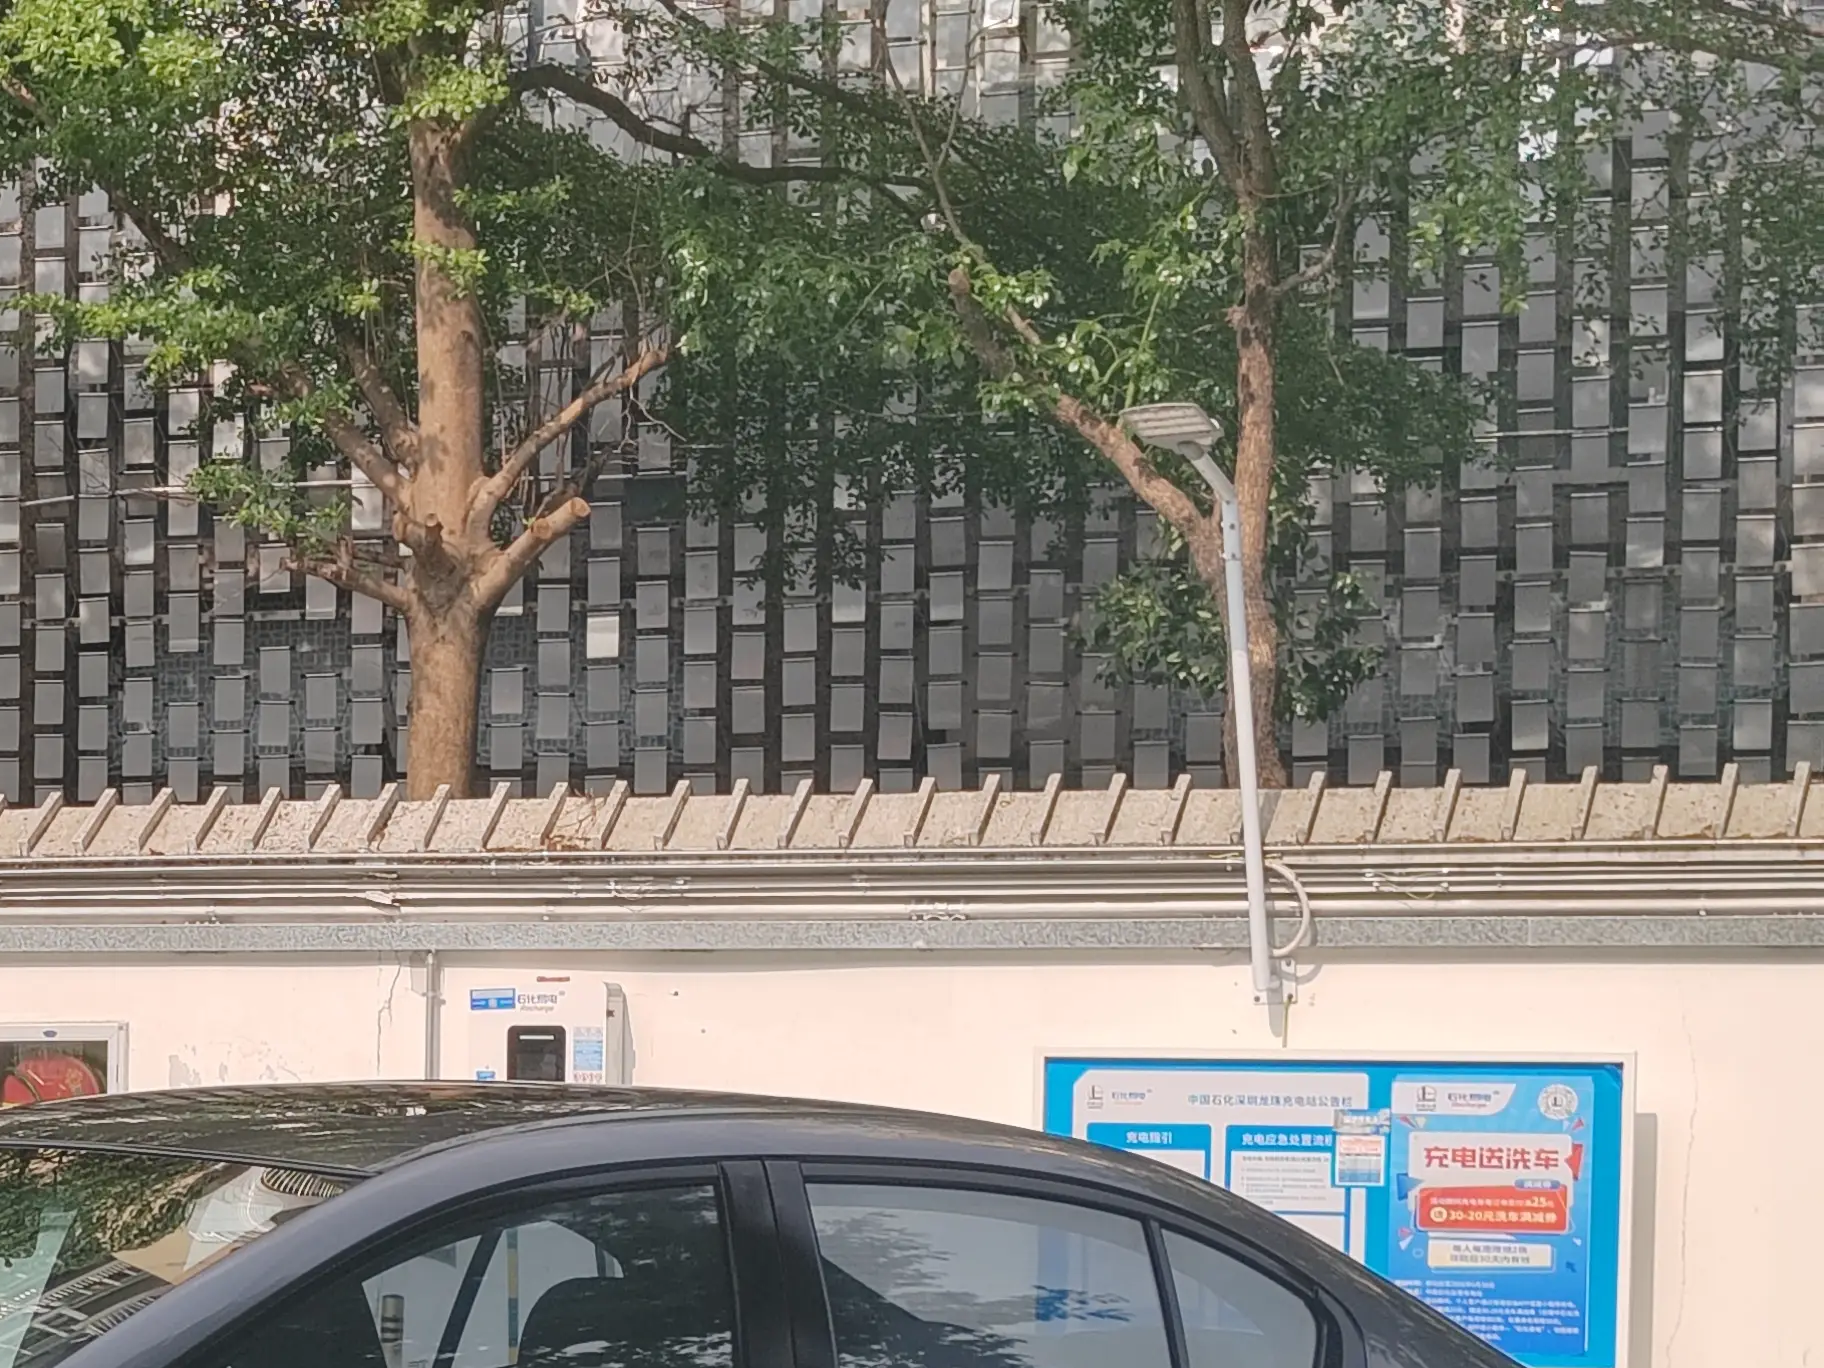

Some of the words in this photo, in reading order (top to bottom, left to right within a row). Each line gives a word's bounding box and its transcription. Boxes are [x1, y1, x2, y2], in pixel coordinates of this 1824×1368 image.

[1126, 1131, 1172, 1145] 充电指引
[1424, 1146, 1559, 1170] 充电送洗车
